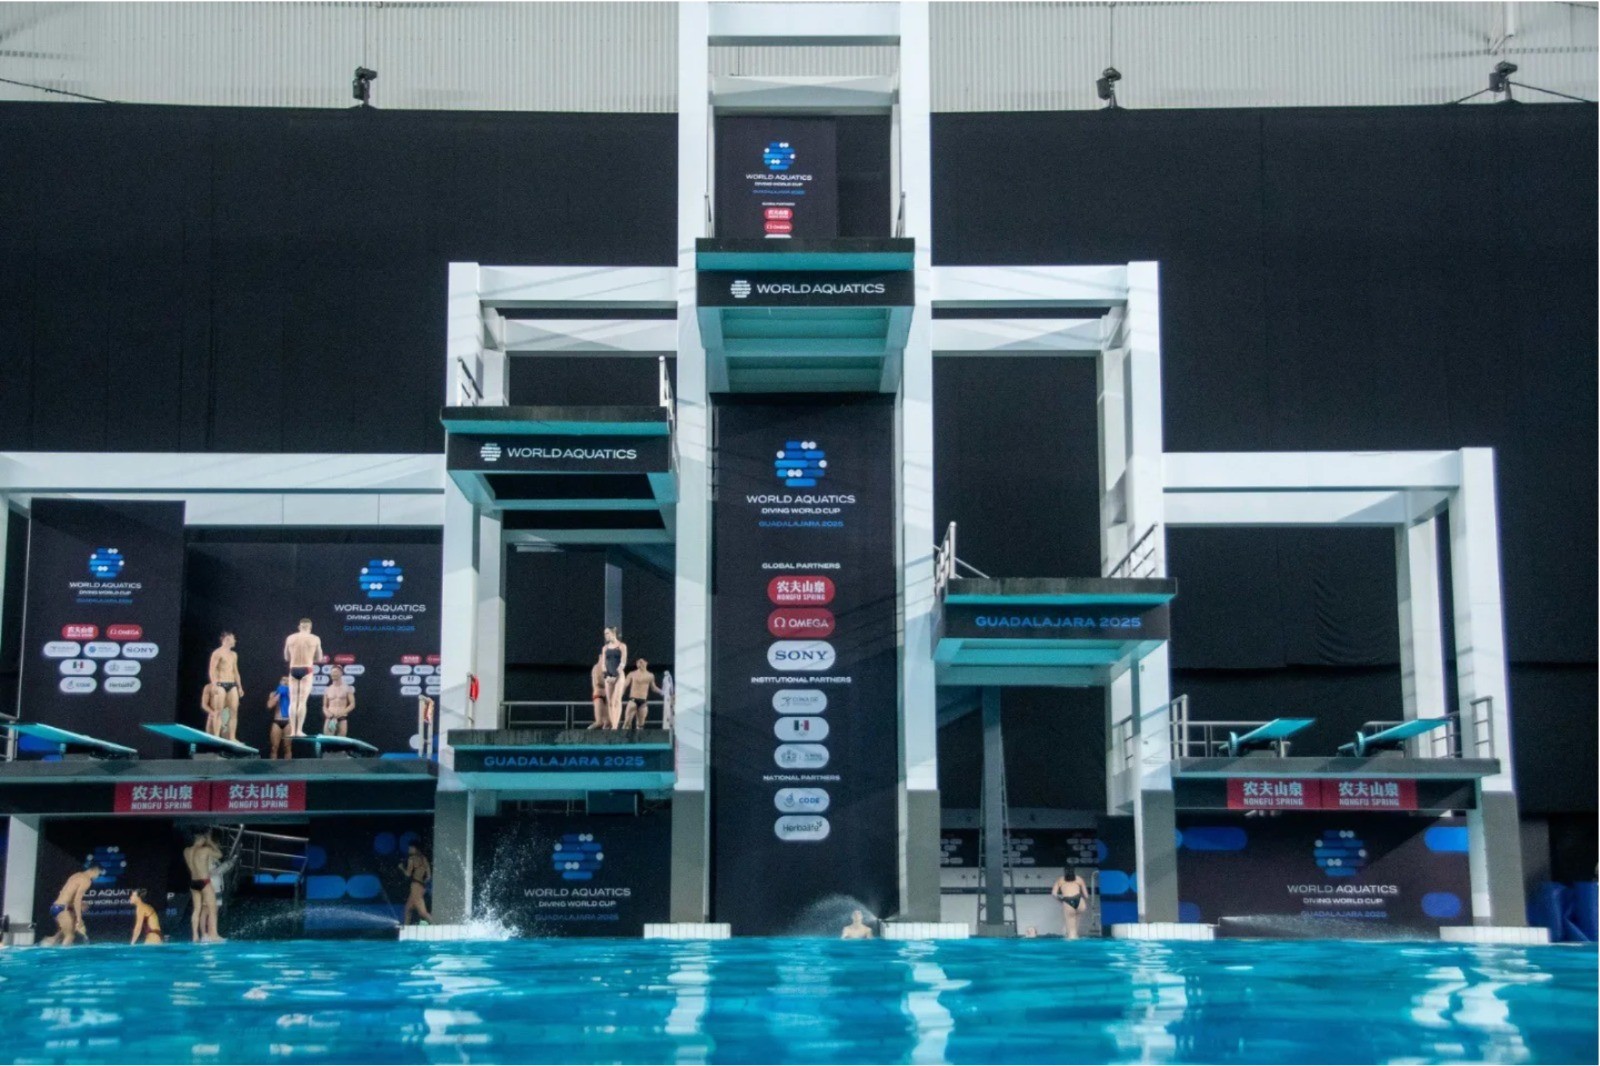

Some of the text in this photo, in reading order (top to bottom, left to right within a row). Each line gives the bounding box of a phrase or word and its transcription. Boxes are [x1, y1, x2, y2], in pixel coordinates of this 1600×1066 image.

[756, 283, 885, 294] WORLD AQUATICS
[507, 447, 637, 460] WORLD AQUATICS
[746, 494, 856, 504] WORLD AQUATICS
[758, 520, 844, 528] GUADALAJARA 2025
[776, 580, 826, 593] 农夫山泉
[776, 593, 826, 601] NONGFU SPRING
[334, 604, 427, 613] WORLD AQUATICS
[788, 618, 829, 628] OMEGA
[975, 616, 1142, 628] GUADALAJARA 2025
[775, 650, 827, 661] SONY
[484, 756, 645, 767] GUADALAJARA 2025
[132, 785, 194, 800] 农夫山泉
[229, 784, 289, 799] 农夫山泉
[1243, 781, 1303, 796] 农夫山泉
[1338, 781, 1399, 797] 农夫山泉
[131, 801, 192, 810] NONGFU SPRING
[228, 800, 288, 809] NONGFU SPRING
[1243, 797, 1304, 806] NONGFU SPRING
[1339, 797, 1399, 806] NONGFU SPRING
[783, 823, 819, 833] Herbalife
[523, 888, 631, 897] WORLD AQUATICS
[1287, 884, 1398, 894] WORLD AQUATICS
[1300, 910, 1387, 918] GUADALAJARA 2025
